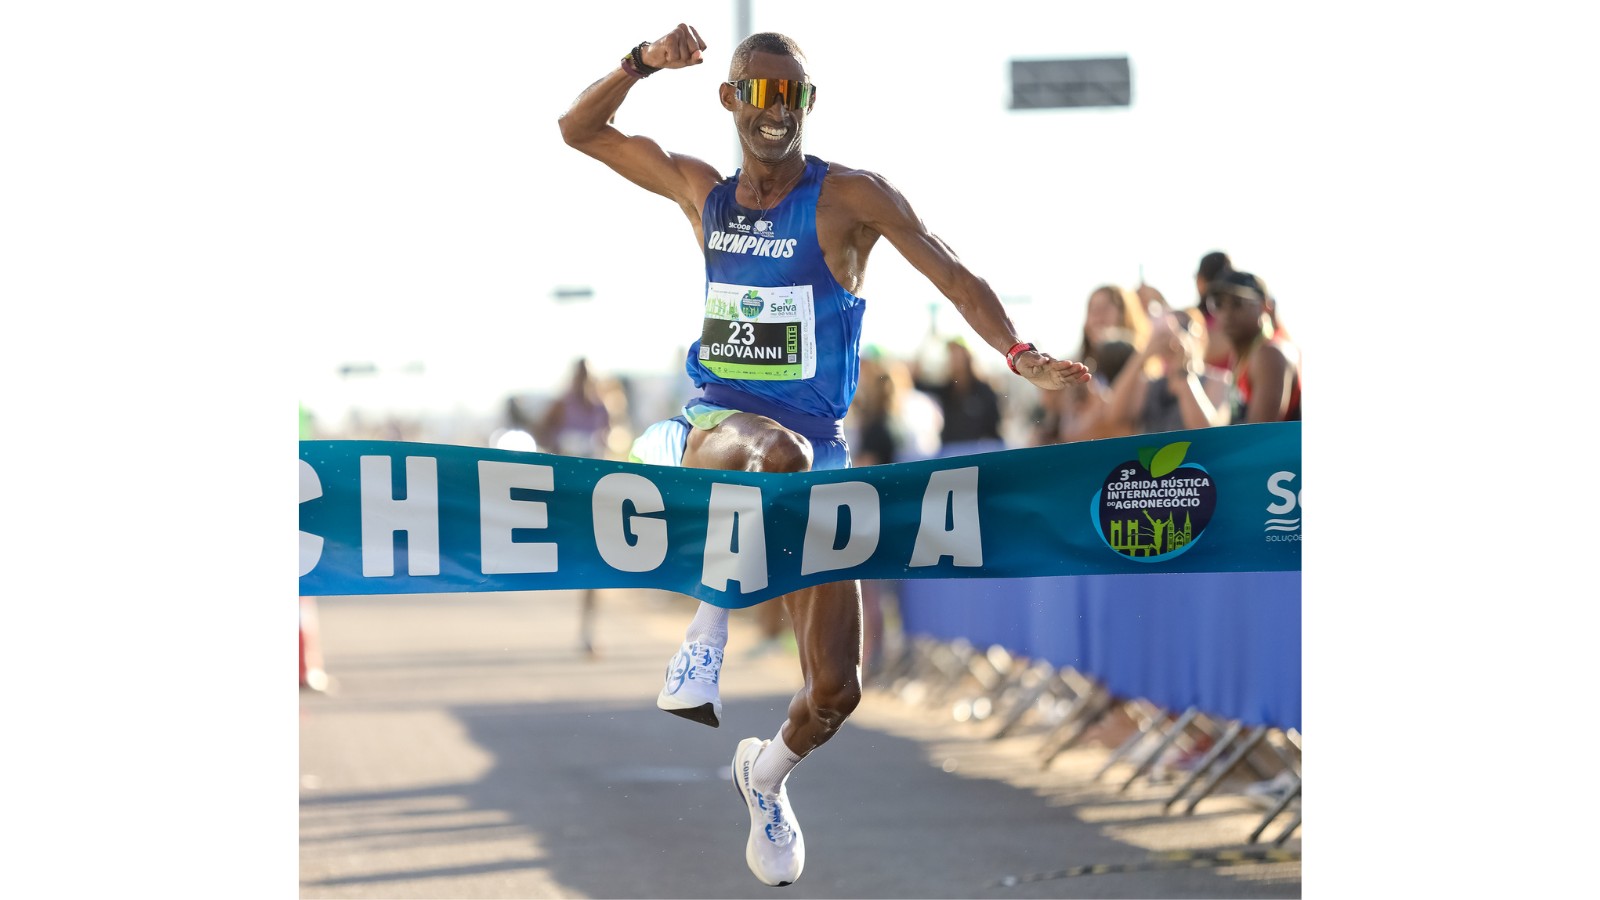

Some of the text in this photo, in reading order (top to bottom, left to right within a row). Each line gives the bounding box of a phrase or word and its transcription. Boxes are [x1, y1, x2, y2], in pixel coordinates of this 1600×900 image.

[708, 231, 798, 258] OLYMPIKUS
[770, 302, 797, 313] Seiva
[727, 321, 756, 346] 23
[788, 326, 797, 352] ELITE
[711, 342, 782, 360] GIOVANNI
[1107, 476, 1210, 491] CORRIDA RÚSTICA
[1266, 470, 1302, 515] S
[1107, 487, 1200, 500] INTERNACIONAL
[1115, 495, 1201, 510] AGRONEGÓCIO
